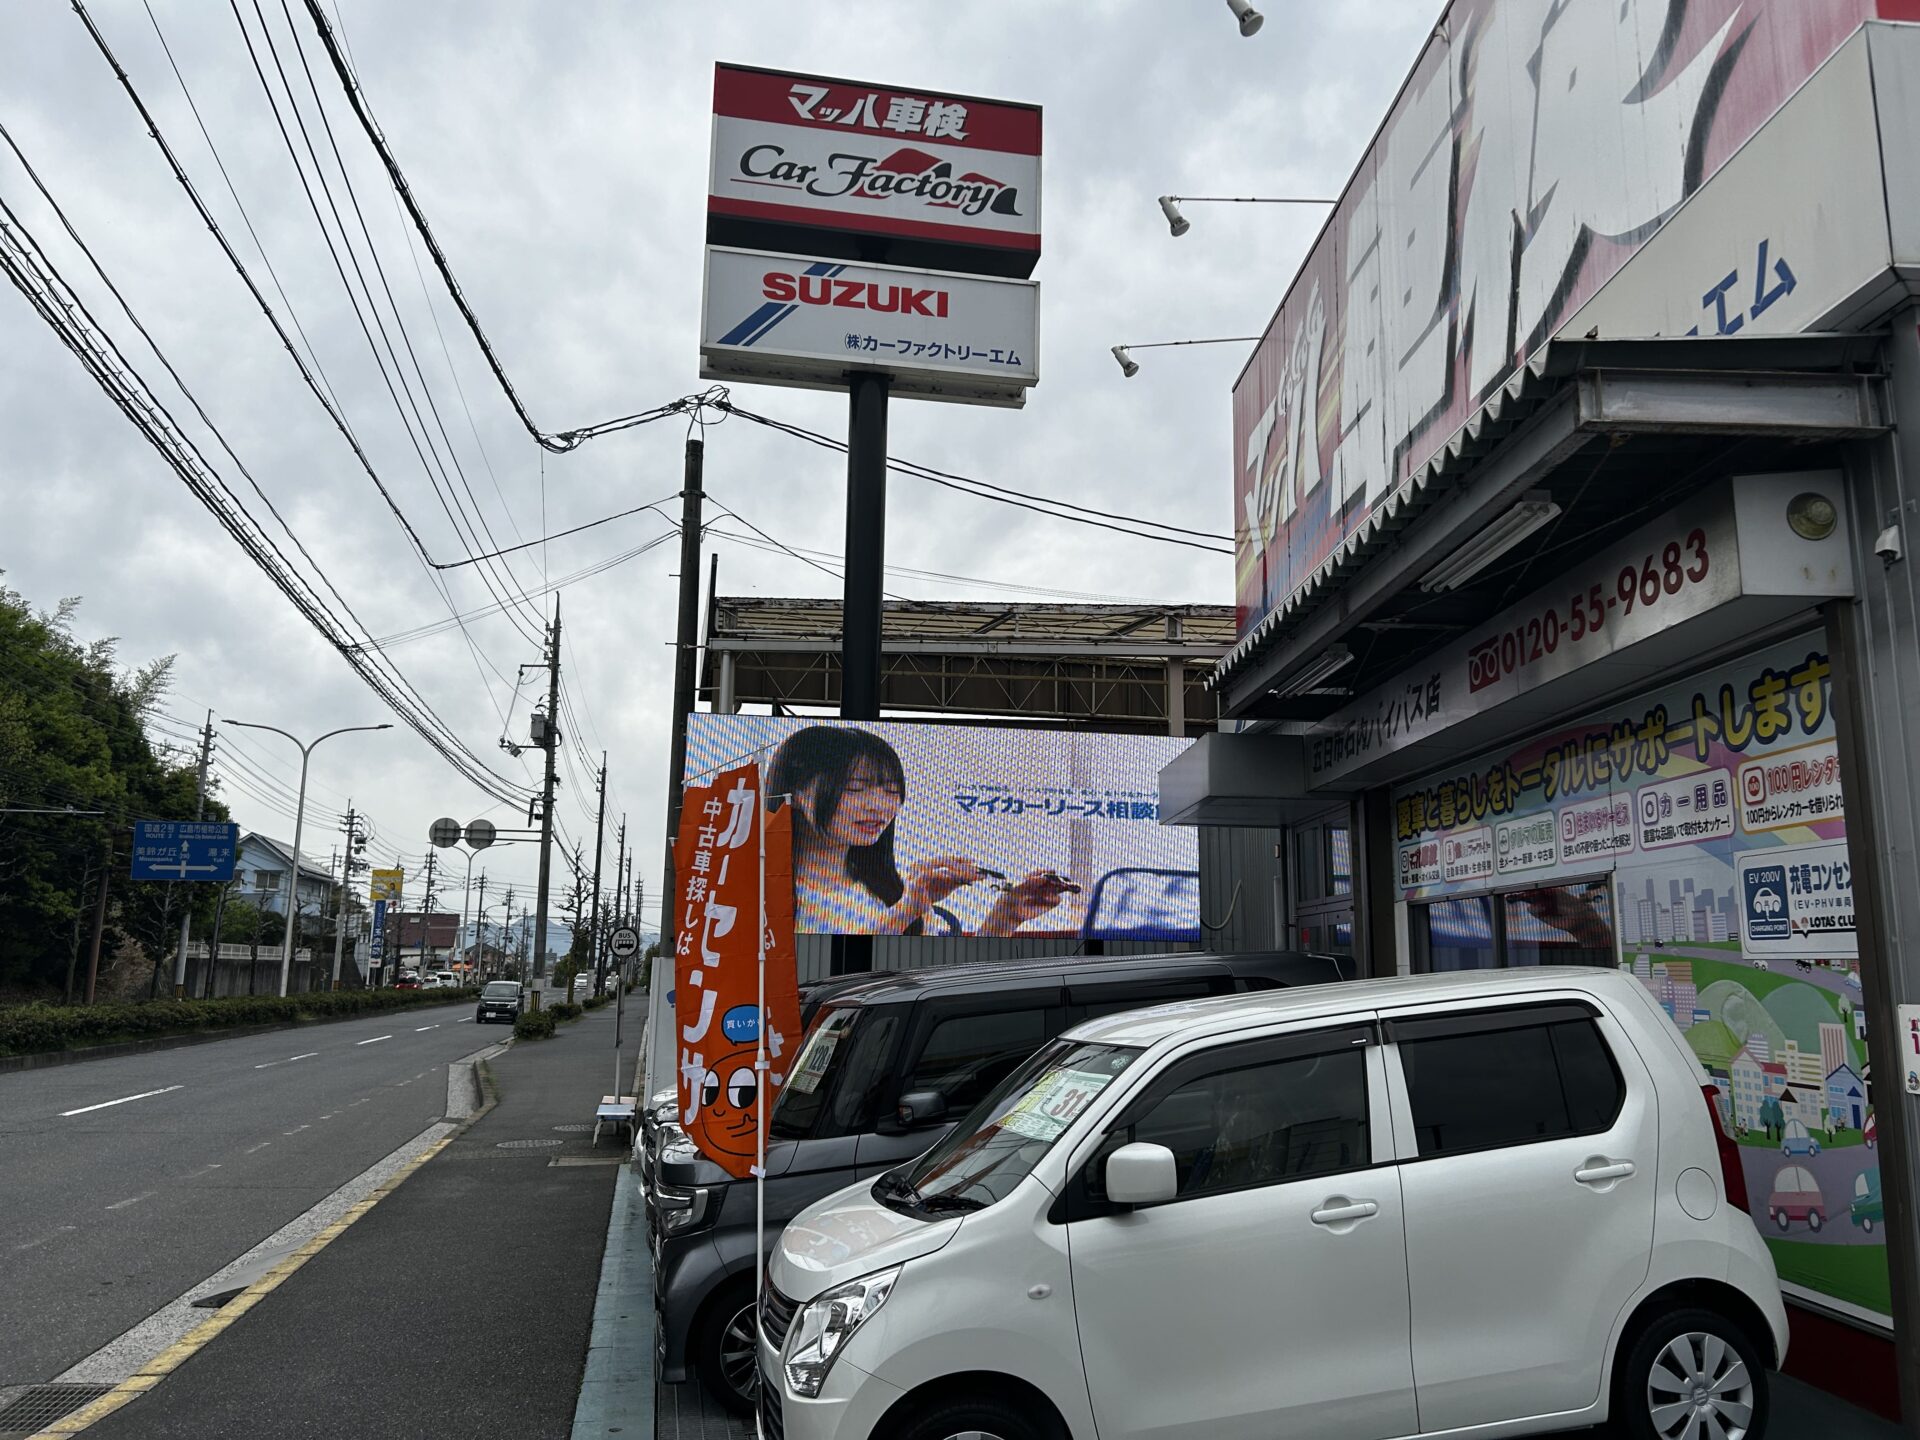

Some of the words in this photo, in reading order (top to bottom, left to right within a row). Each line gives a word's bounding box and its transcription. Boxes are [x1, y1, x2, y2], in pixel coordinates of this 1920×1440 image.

[788, 83, 971, 140] マッハ車検
[740, 144, 817, 182] Car
[806, 152, 1023, 216] Factory
[762, 272, 948, 318] SUZUKI
[1501, 528, 1710, 675] 0120-55-9683
[954, 794, 1160, 821] マイカーリース相談
[1659, 780, 1729, 818] カー用品
[144, 823, 175, 833] 国道2号
[676, 796, 723, 956] 中古車探しは
[1749, 873, 1760, 884] EV
[1761, 871, 1781, 883] 200V
[1751, 924, 1773, 932] CHARGING
[1774, 924, 1788, 932] POINT
[1809, 916, 1836, 928] LOTAS
[681, 777, 756, 1143] カーセンサ
